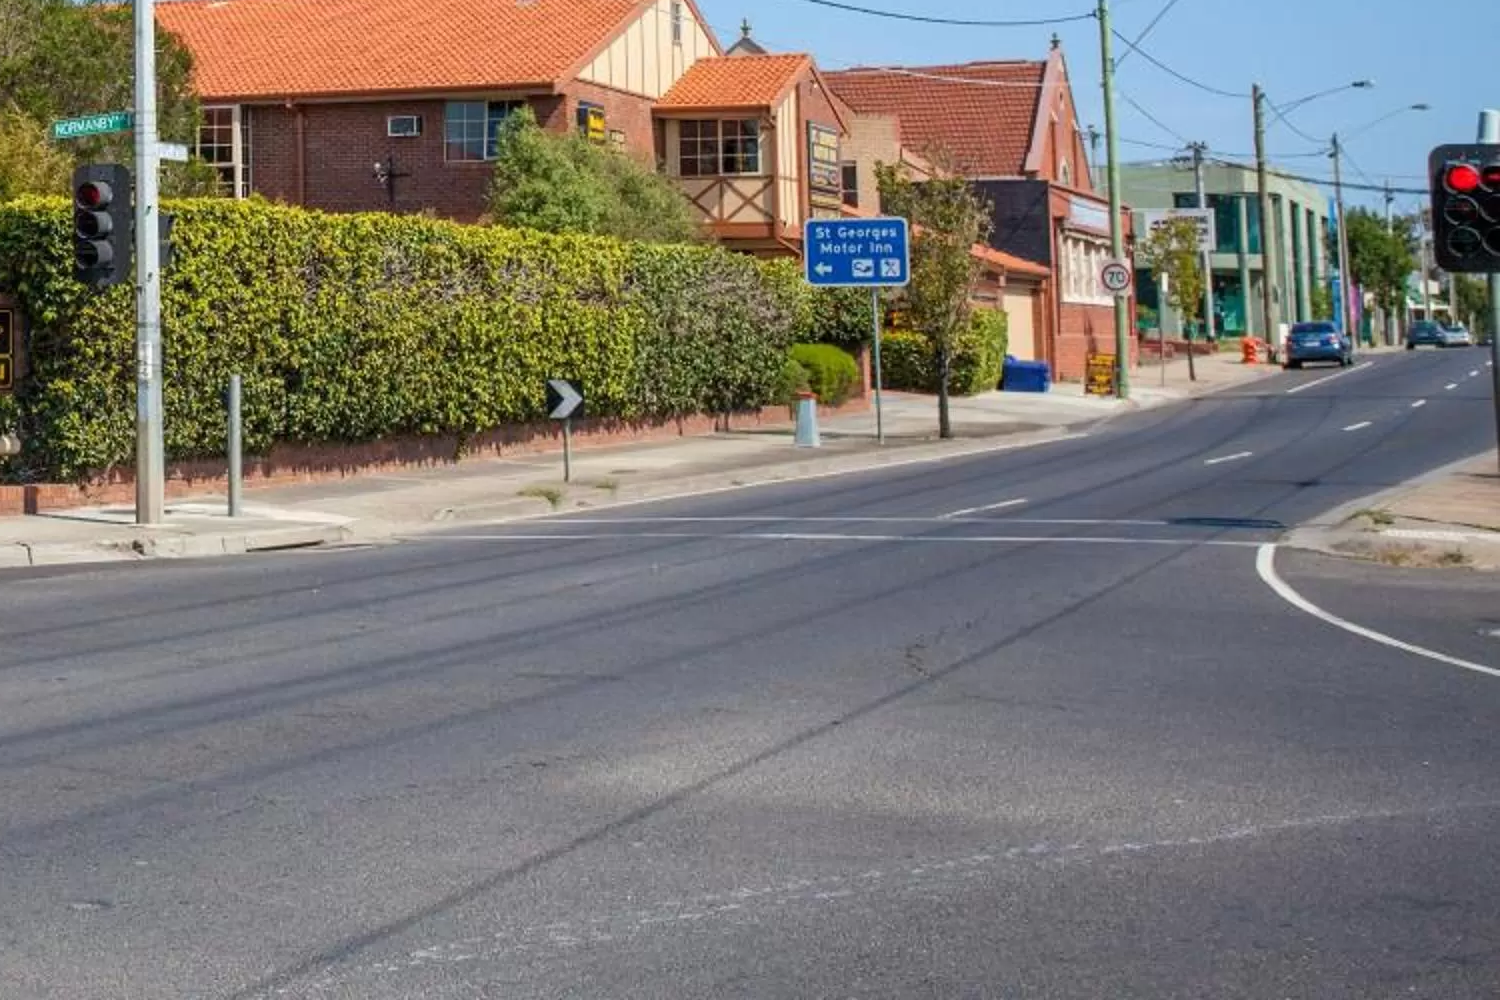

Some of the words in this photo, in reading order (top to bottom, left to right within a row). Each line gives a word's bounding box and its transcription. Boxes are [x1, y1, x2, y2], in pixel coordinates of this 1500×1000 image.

[55, 116, 113, 137] NORMANBY
[815, 227, 831, 239] St
[837, 227, 897, 241] Georges
[820, 243, 863, 254] Motor
[869, 242, 893, 253] Inn
[1107, 270, 1126, 282] 70
